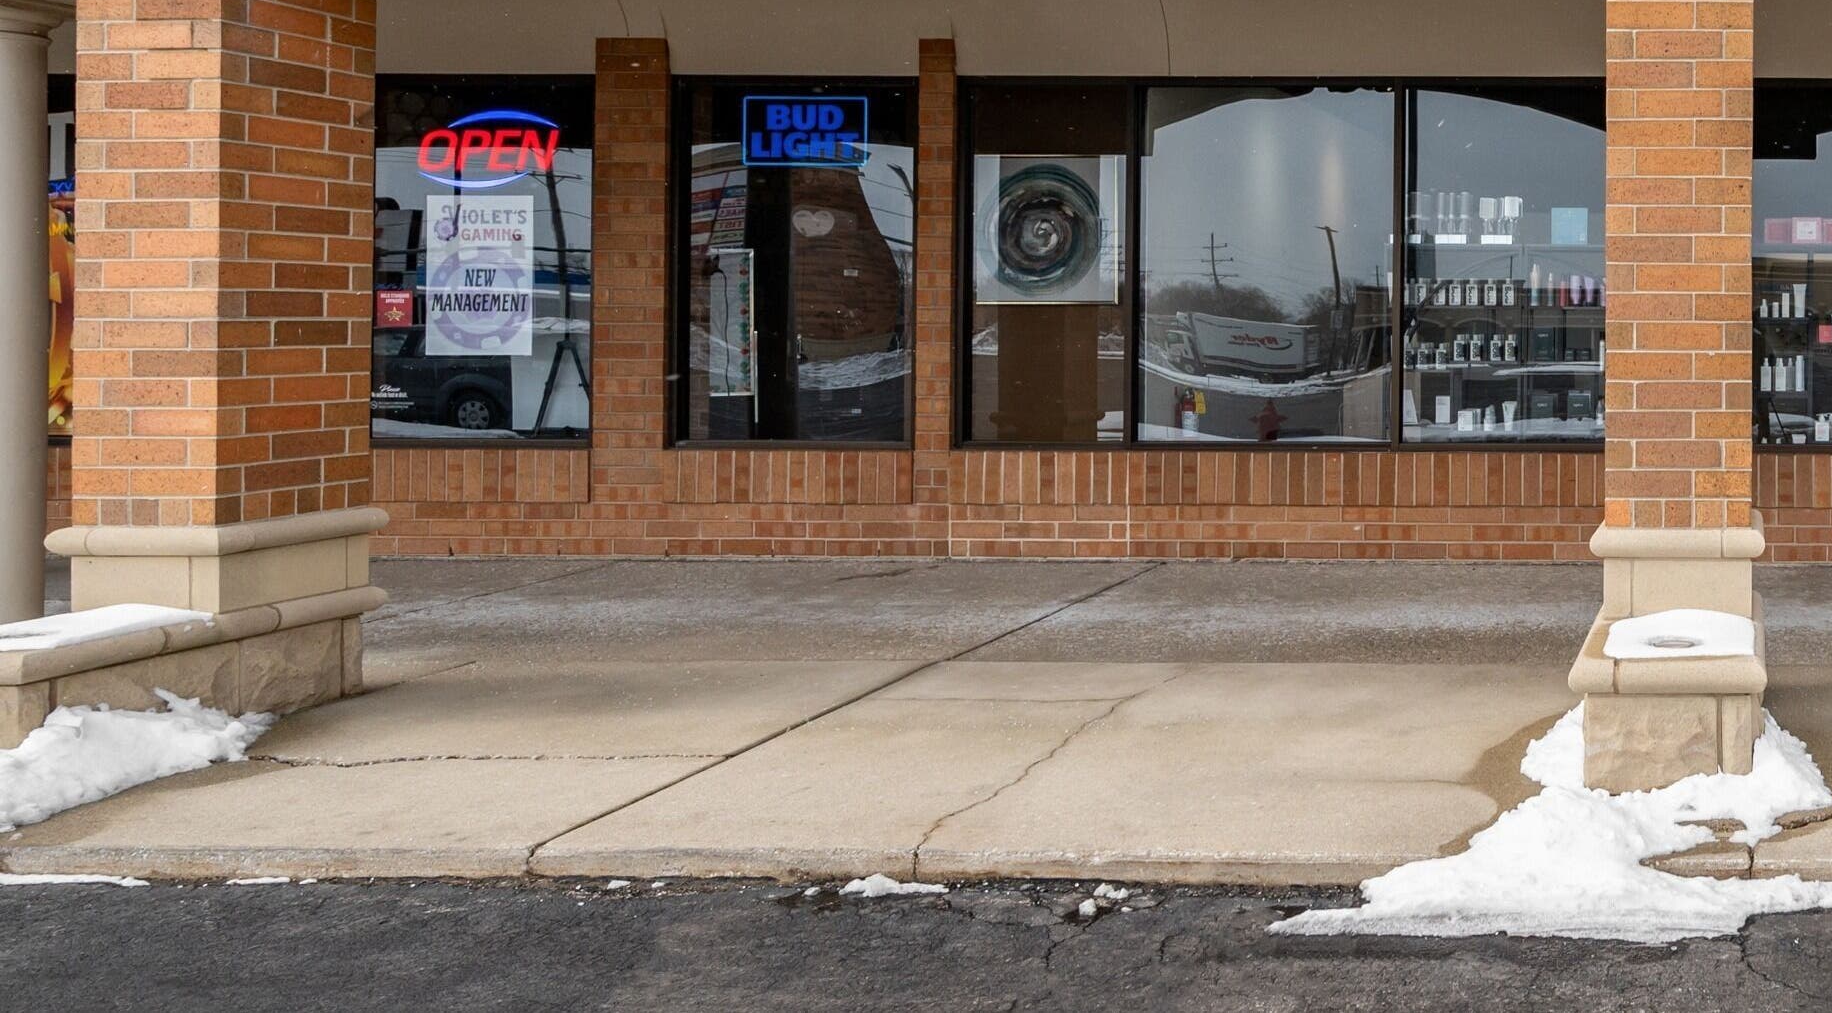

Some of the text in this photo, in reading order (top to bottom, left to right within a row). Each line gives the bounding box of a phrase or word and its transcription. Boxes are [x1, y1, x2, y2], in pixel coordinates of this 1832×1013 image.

[766, 104, 844, 130] BUD
[417, 129, 560, 172] OPEN
[751, 131, 859, 158] LIGHT
[461, 228, 522, 241] GAMING
[465, 269, 496, 287] NEW
[432, 293, 528, 312] MANAGEMENT
